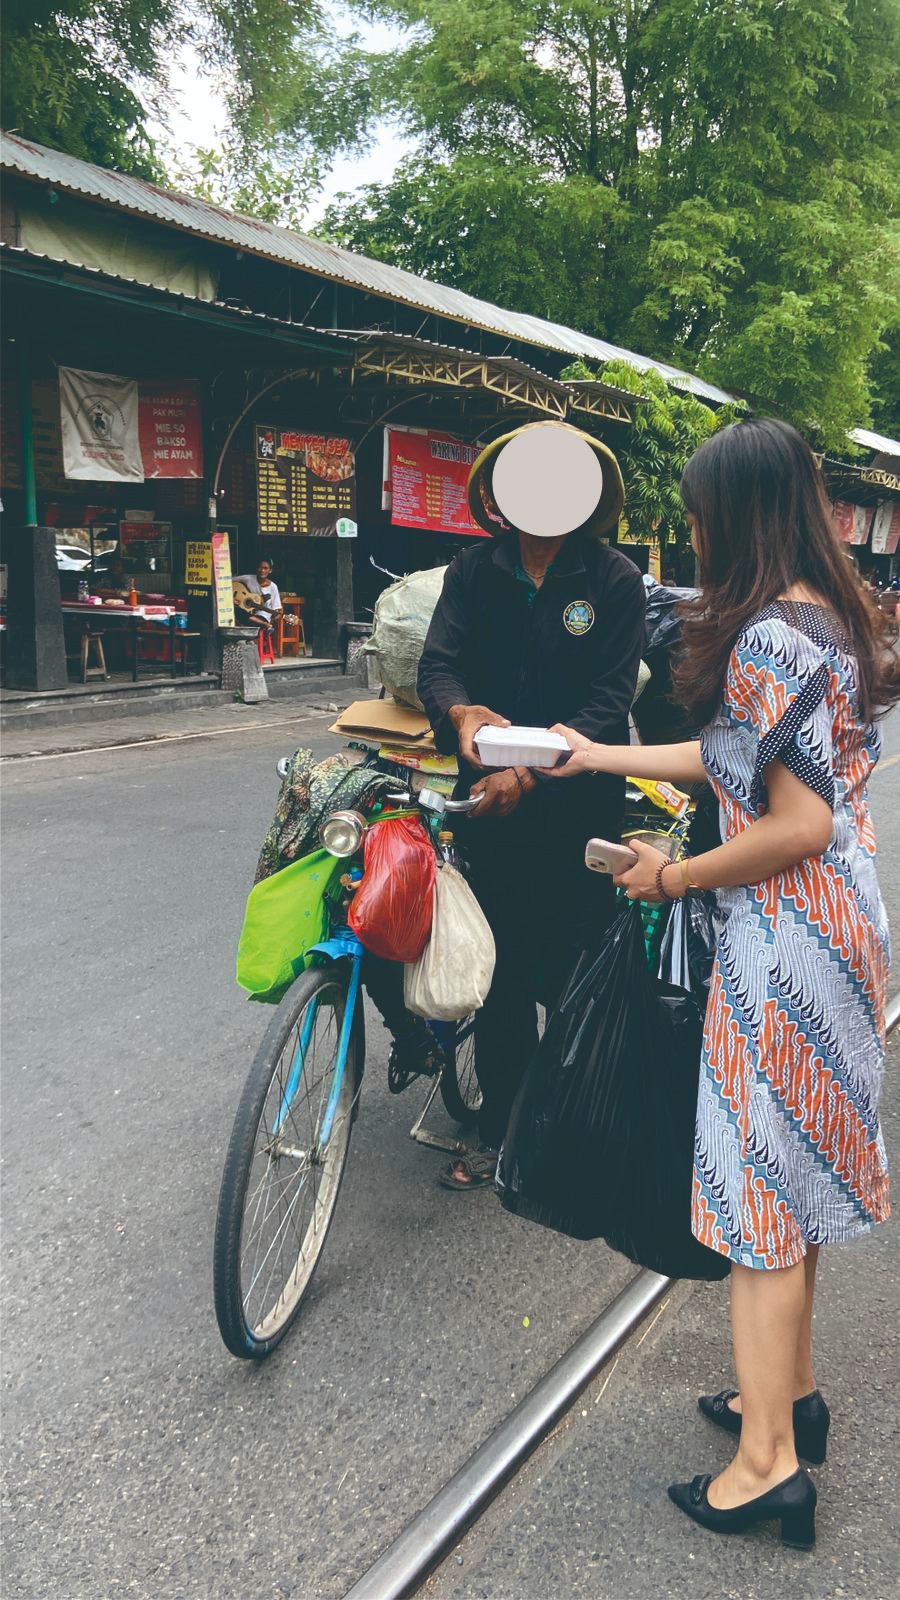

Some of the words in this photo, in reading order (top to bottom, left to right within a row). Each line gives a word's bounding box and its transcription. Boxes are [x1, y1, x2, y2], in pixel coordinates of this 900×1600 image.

[155, 423, 171, 433] MIE
[173, 424, 185, 433] SO
[157, 437, 186, 446] BAKSO
[153, 449, 169, 459] MIE
[171, 450, 193, 460] AYAM
